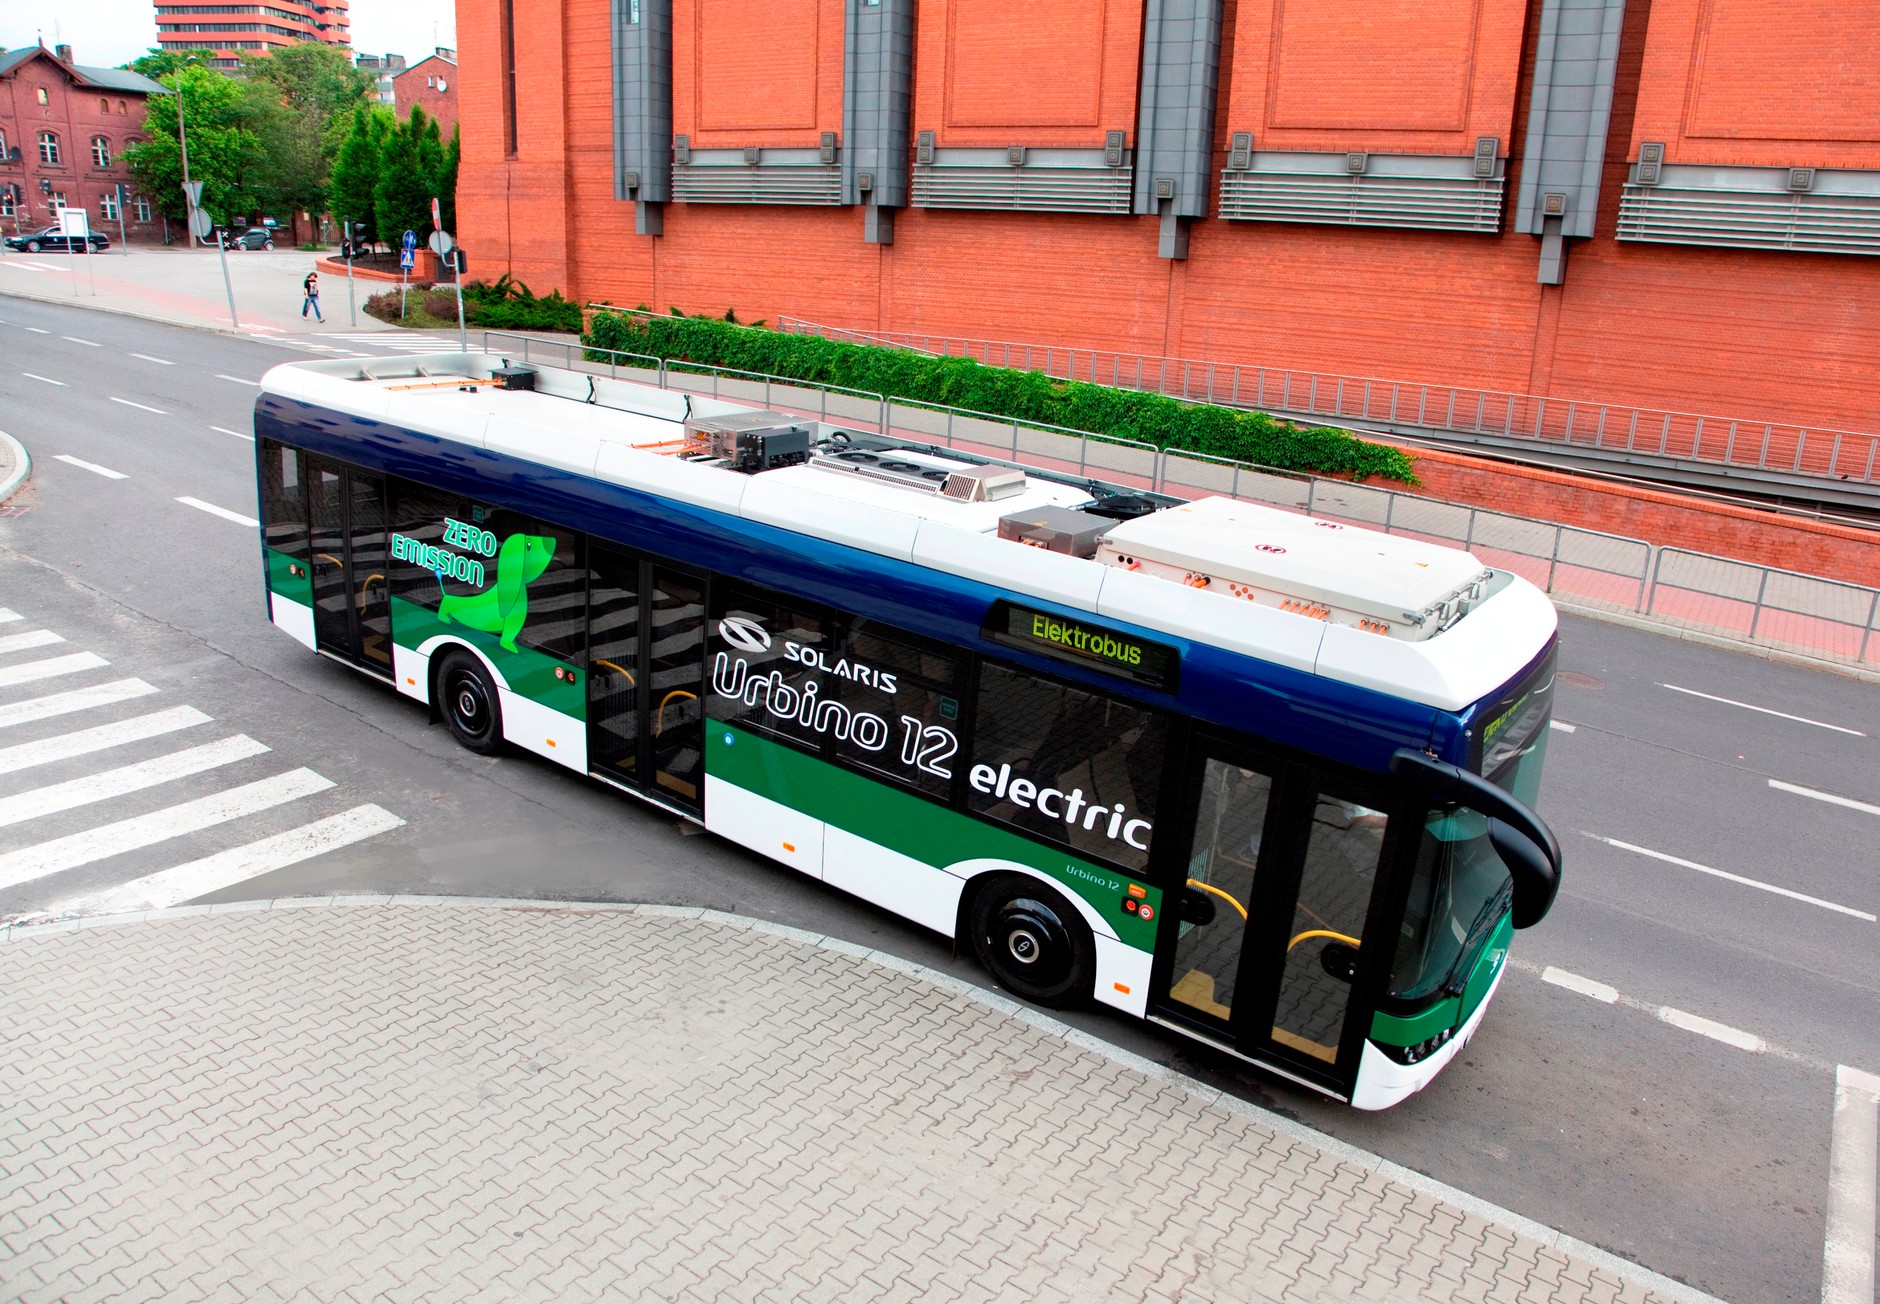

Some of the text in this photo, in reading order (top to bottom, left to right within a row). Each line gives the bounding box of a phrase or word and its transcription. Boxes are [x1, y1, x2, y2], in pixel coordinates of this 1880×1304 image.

[443, 517, 497, 557] ZERO
[1032, 613, 1142, 665] Elektrobus
[784, 641, 898, 694] SOLARIS
[713, 652, 959, 779] Urbino 12
[969, 763, 1152, 850] electric
[1066, 864, 1120, 892] Urbino 12
